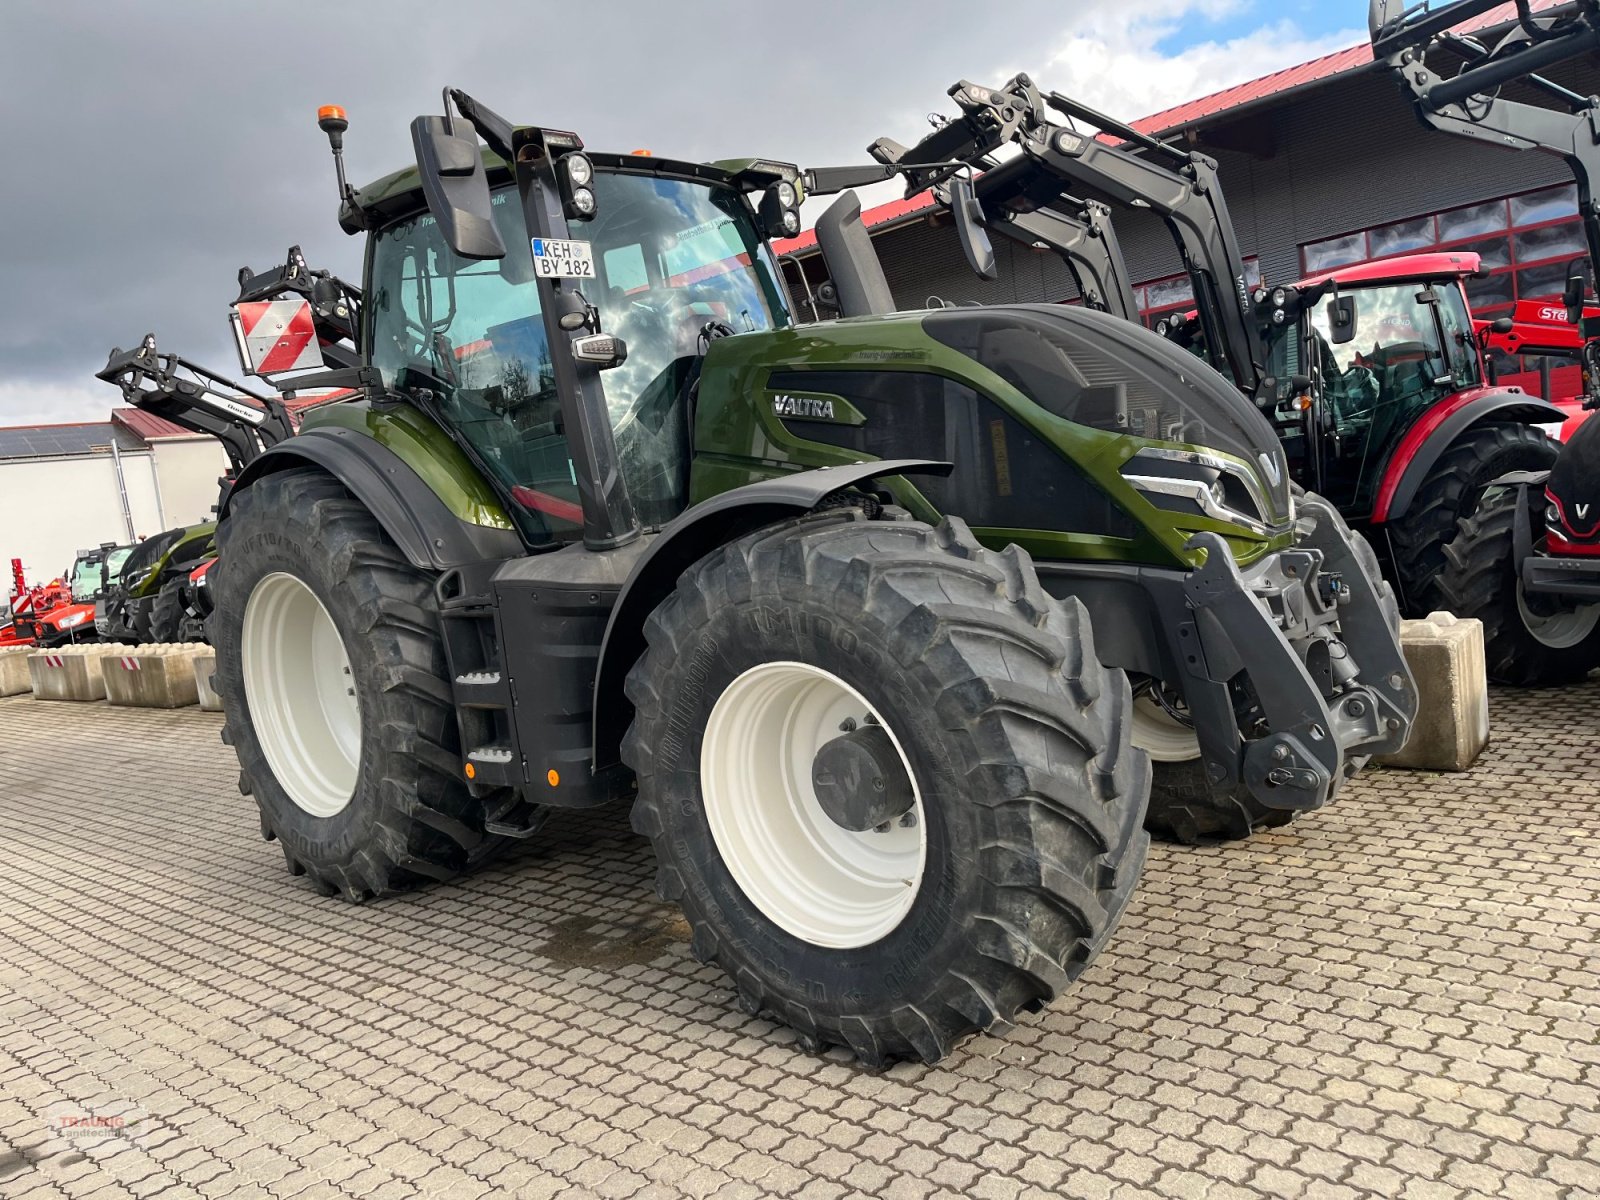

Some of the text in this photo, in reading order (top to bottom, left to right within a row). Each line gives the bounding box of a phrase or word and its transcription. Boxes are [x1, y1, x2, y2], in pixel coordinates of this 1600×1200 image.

[543, 242, 571, 258] KEH
[541, 259, 591, 276] BY 182
[774, 394, 834, 419] VALTRA
